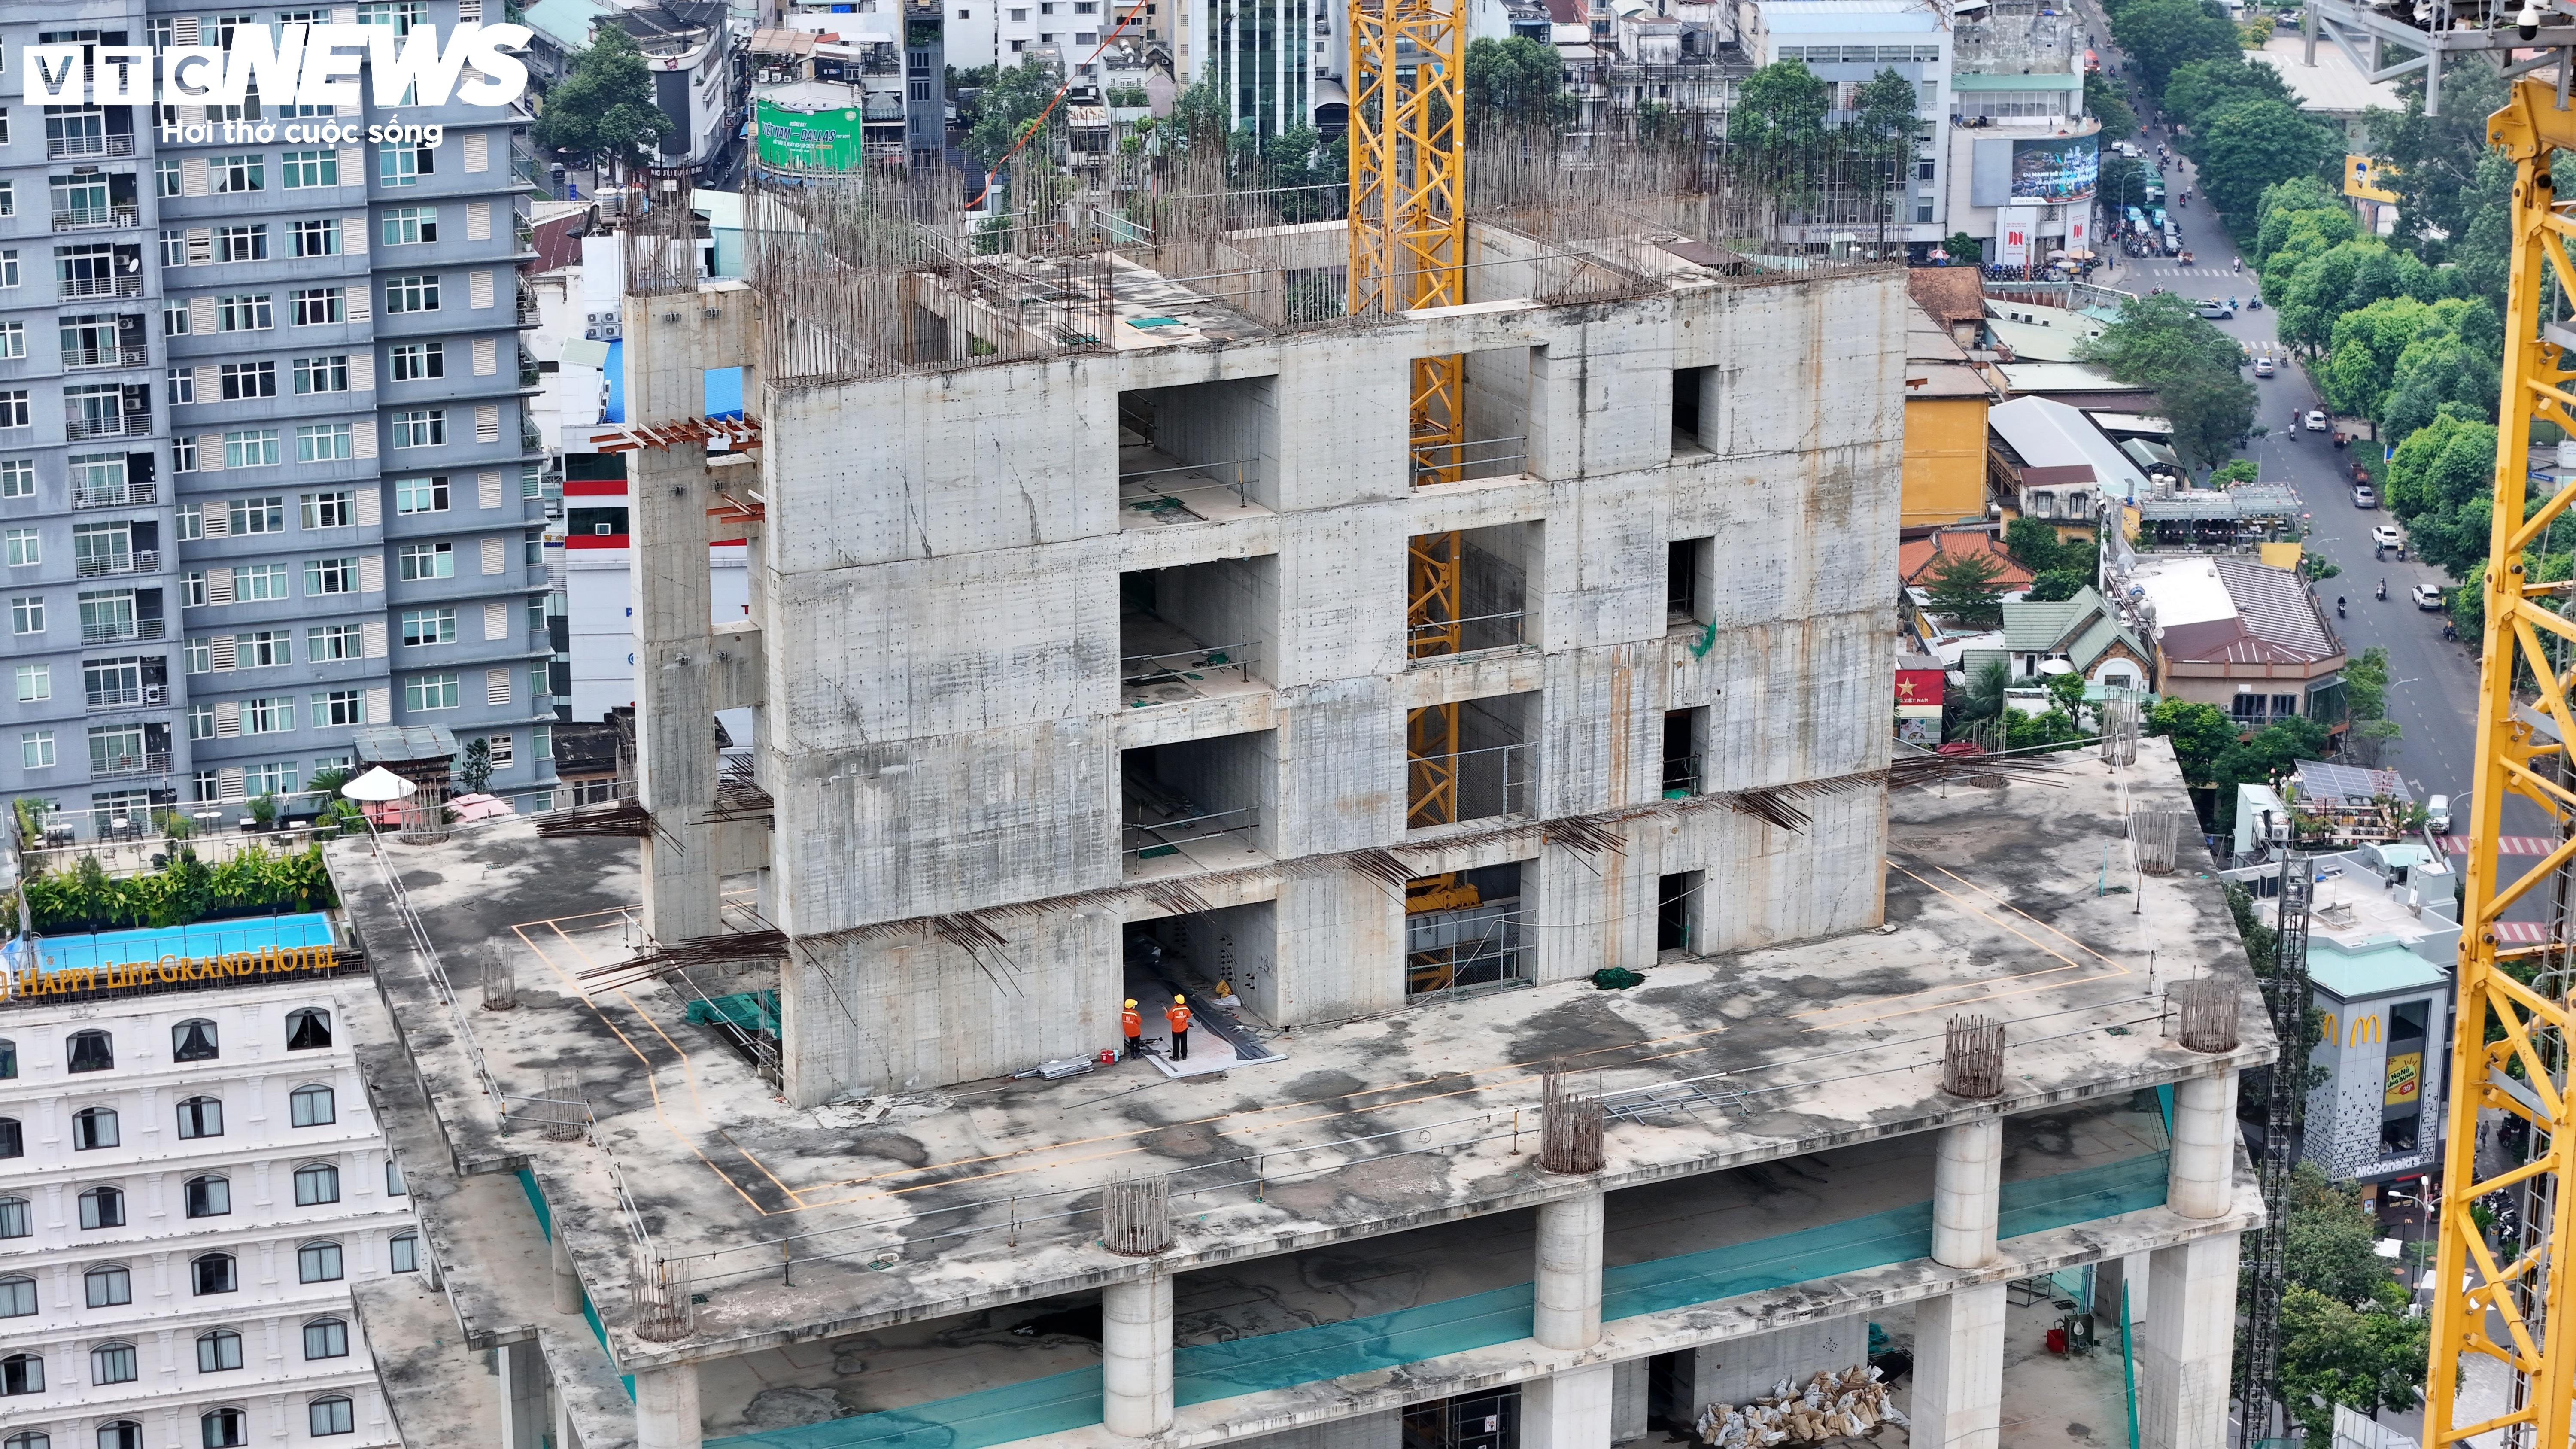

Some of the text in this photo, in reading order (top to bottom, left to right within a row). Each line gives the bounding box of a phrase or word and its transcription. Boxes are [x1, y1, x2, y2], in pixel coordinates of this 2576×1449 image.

[762, 122, 774, 138] VIỆT
[774, 126, 791, 140] NAM
[800, 129, 836, 142] DALLAS
[17, 944, 339, 997] HAPPY LIFE GRAND HOTEL
[2355, 1156, 2421, 1177] McDonald's
